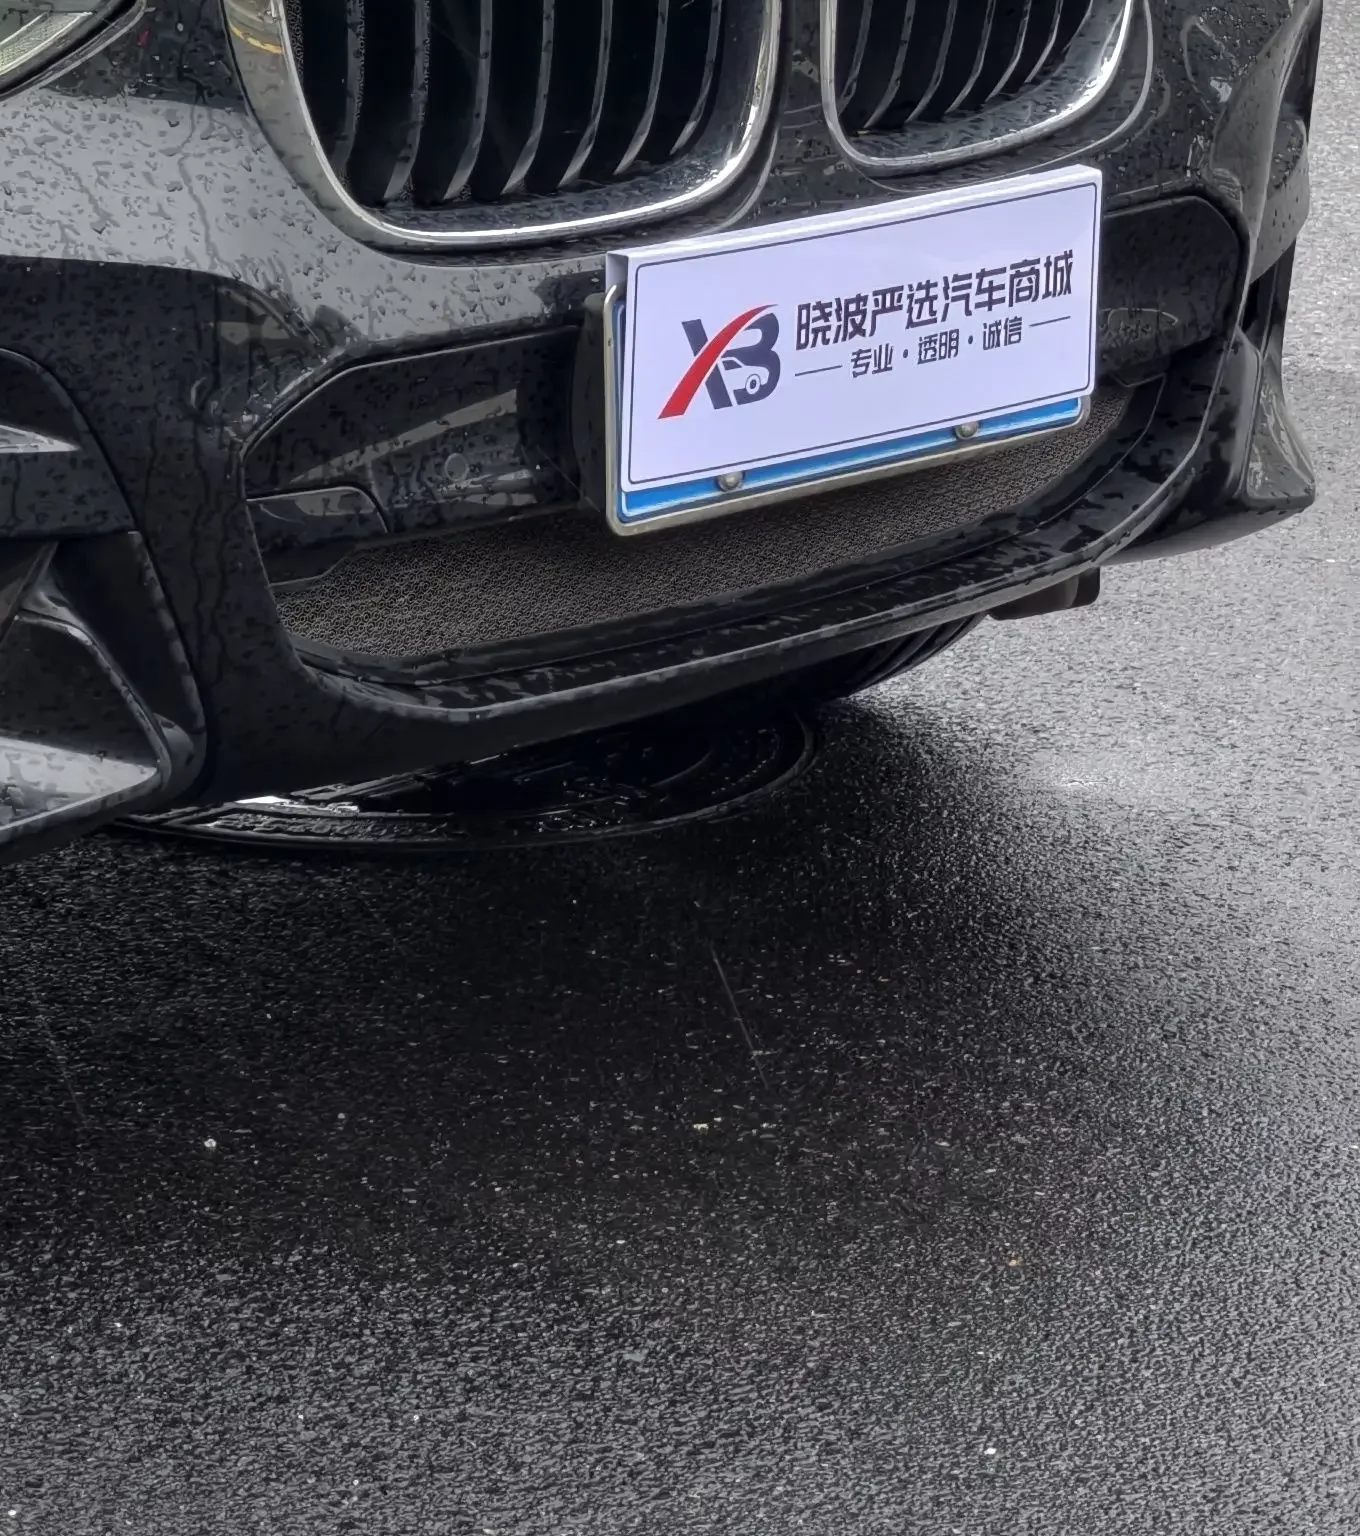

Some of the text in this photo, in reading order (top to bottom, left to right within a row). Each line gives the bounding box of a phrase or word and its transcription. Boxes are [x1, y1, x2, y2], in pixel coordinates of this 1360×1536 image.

[795, 249, 1074, 351] 晓波严选汽车商城
